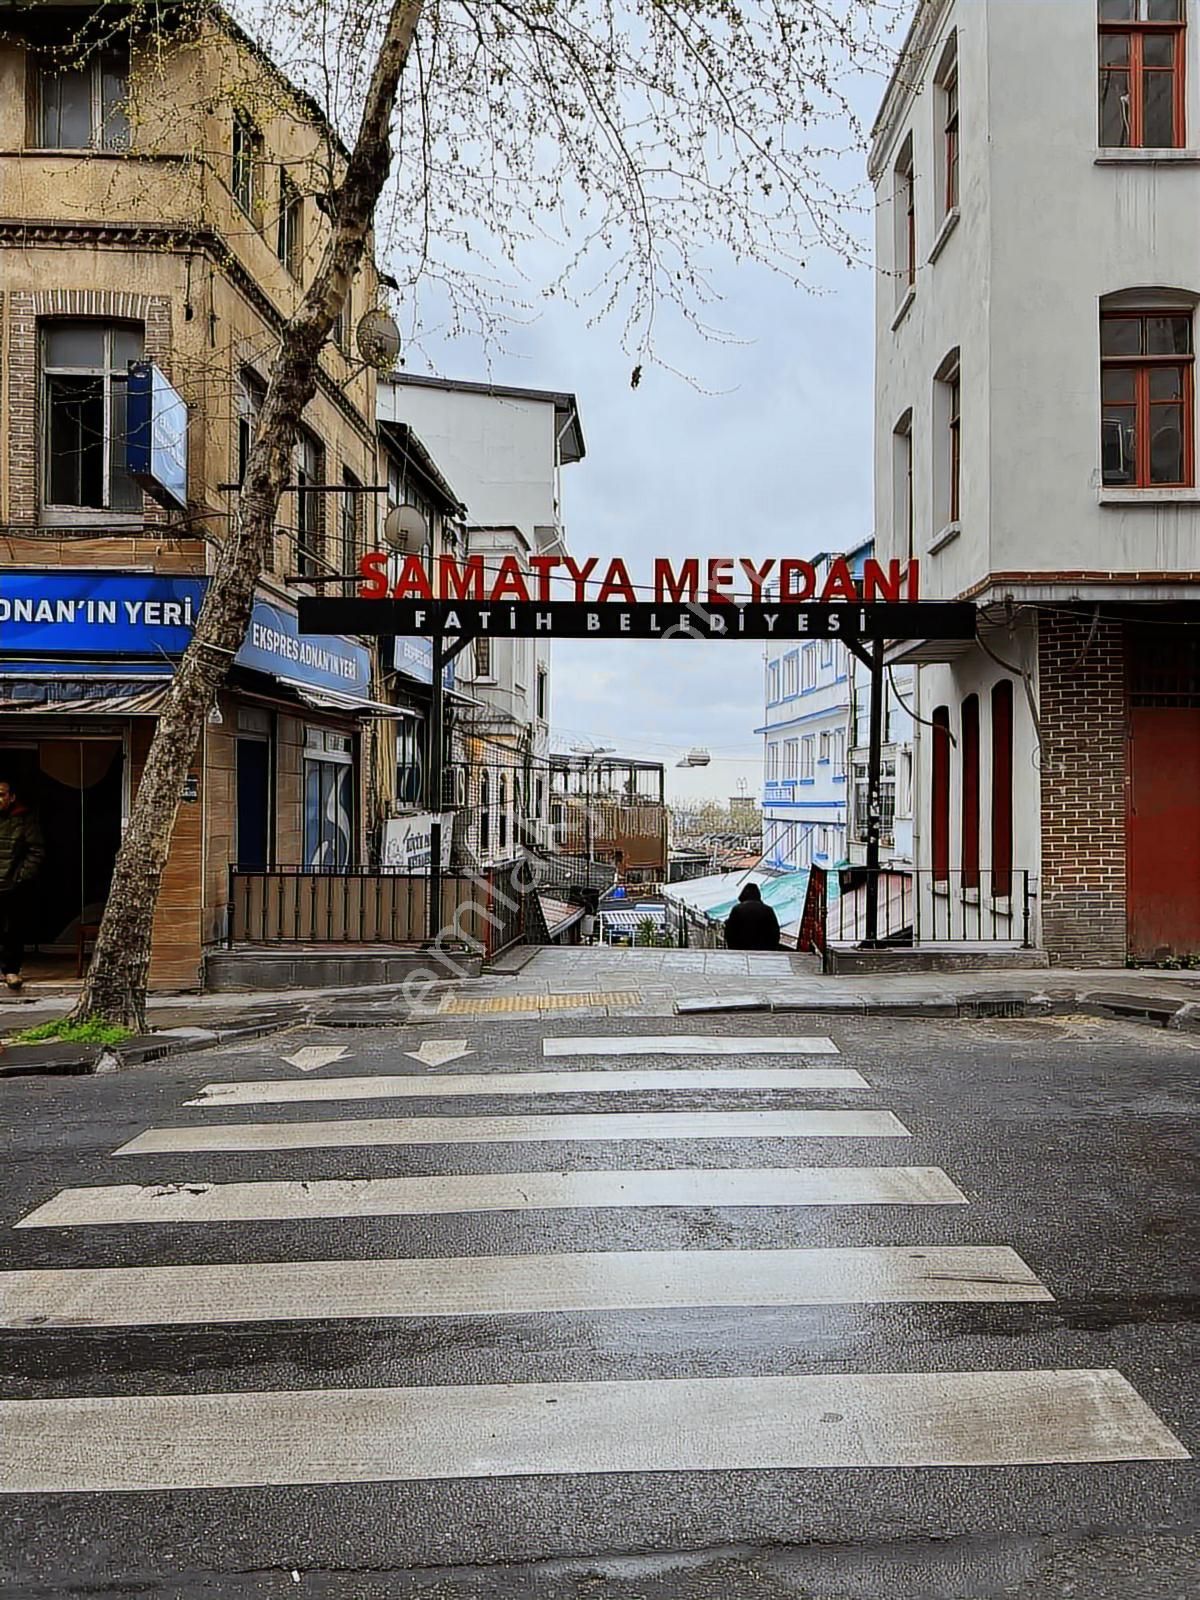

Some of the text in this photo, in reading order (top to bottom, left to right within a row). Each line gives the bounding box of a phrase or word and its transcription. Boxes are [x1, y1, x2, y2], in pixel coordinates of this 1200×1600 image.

[358, 552, 920, 603] SAMATYA MEYDANI
[123, 597, 191, 625] YERİ
[414, 607, 867, 632] FATİH BELEDİYESİ
[252, 624, 300, 660] EKSPRES
[339, 657, 357, 681] YERİ
